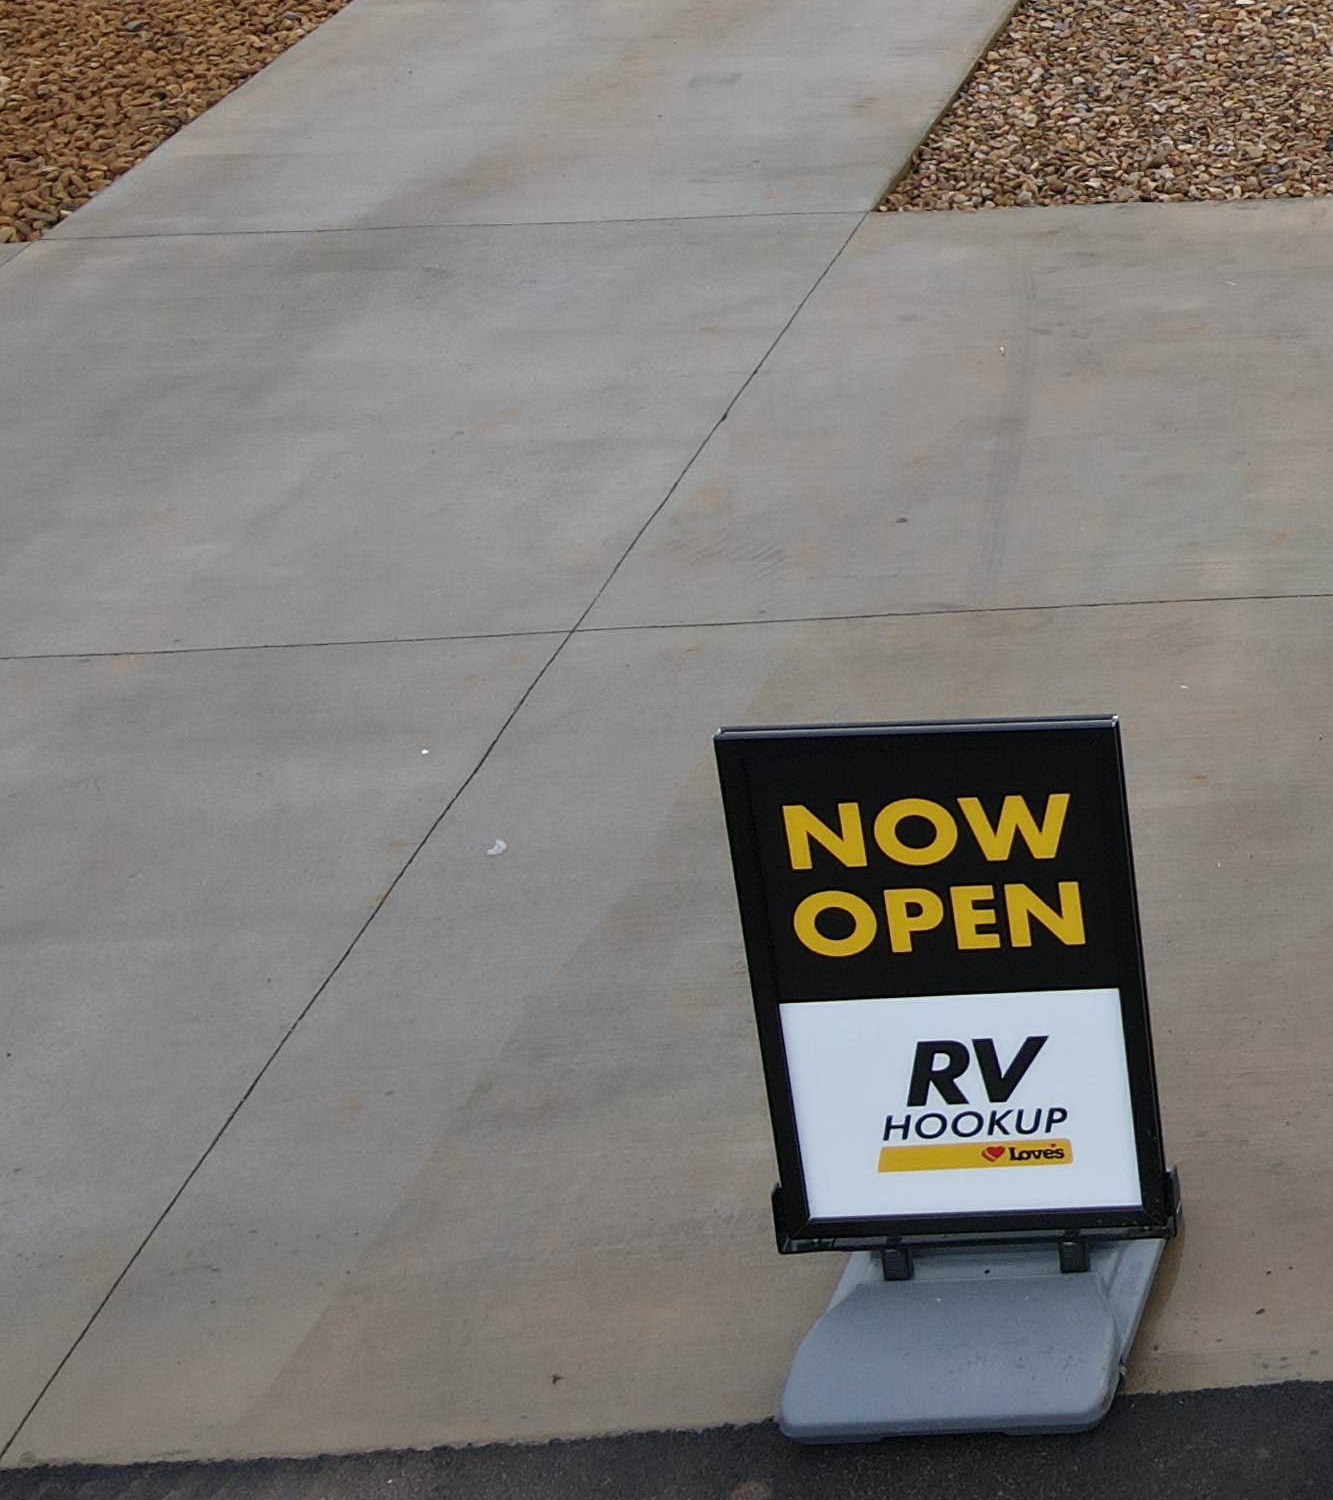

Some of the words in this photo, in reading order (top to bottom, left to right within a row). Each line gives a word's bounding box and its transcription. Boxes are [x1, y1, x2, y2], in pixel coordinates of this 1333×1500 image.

[782, 793, 1071, 870] NOW
[793, 881, 1087, 958] OPEN
[906, 1036, 1050, 1108] RV
[882, 1106, 1069, 1142] HOOKUP
